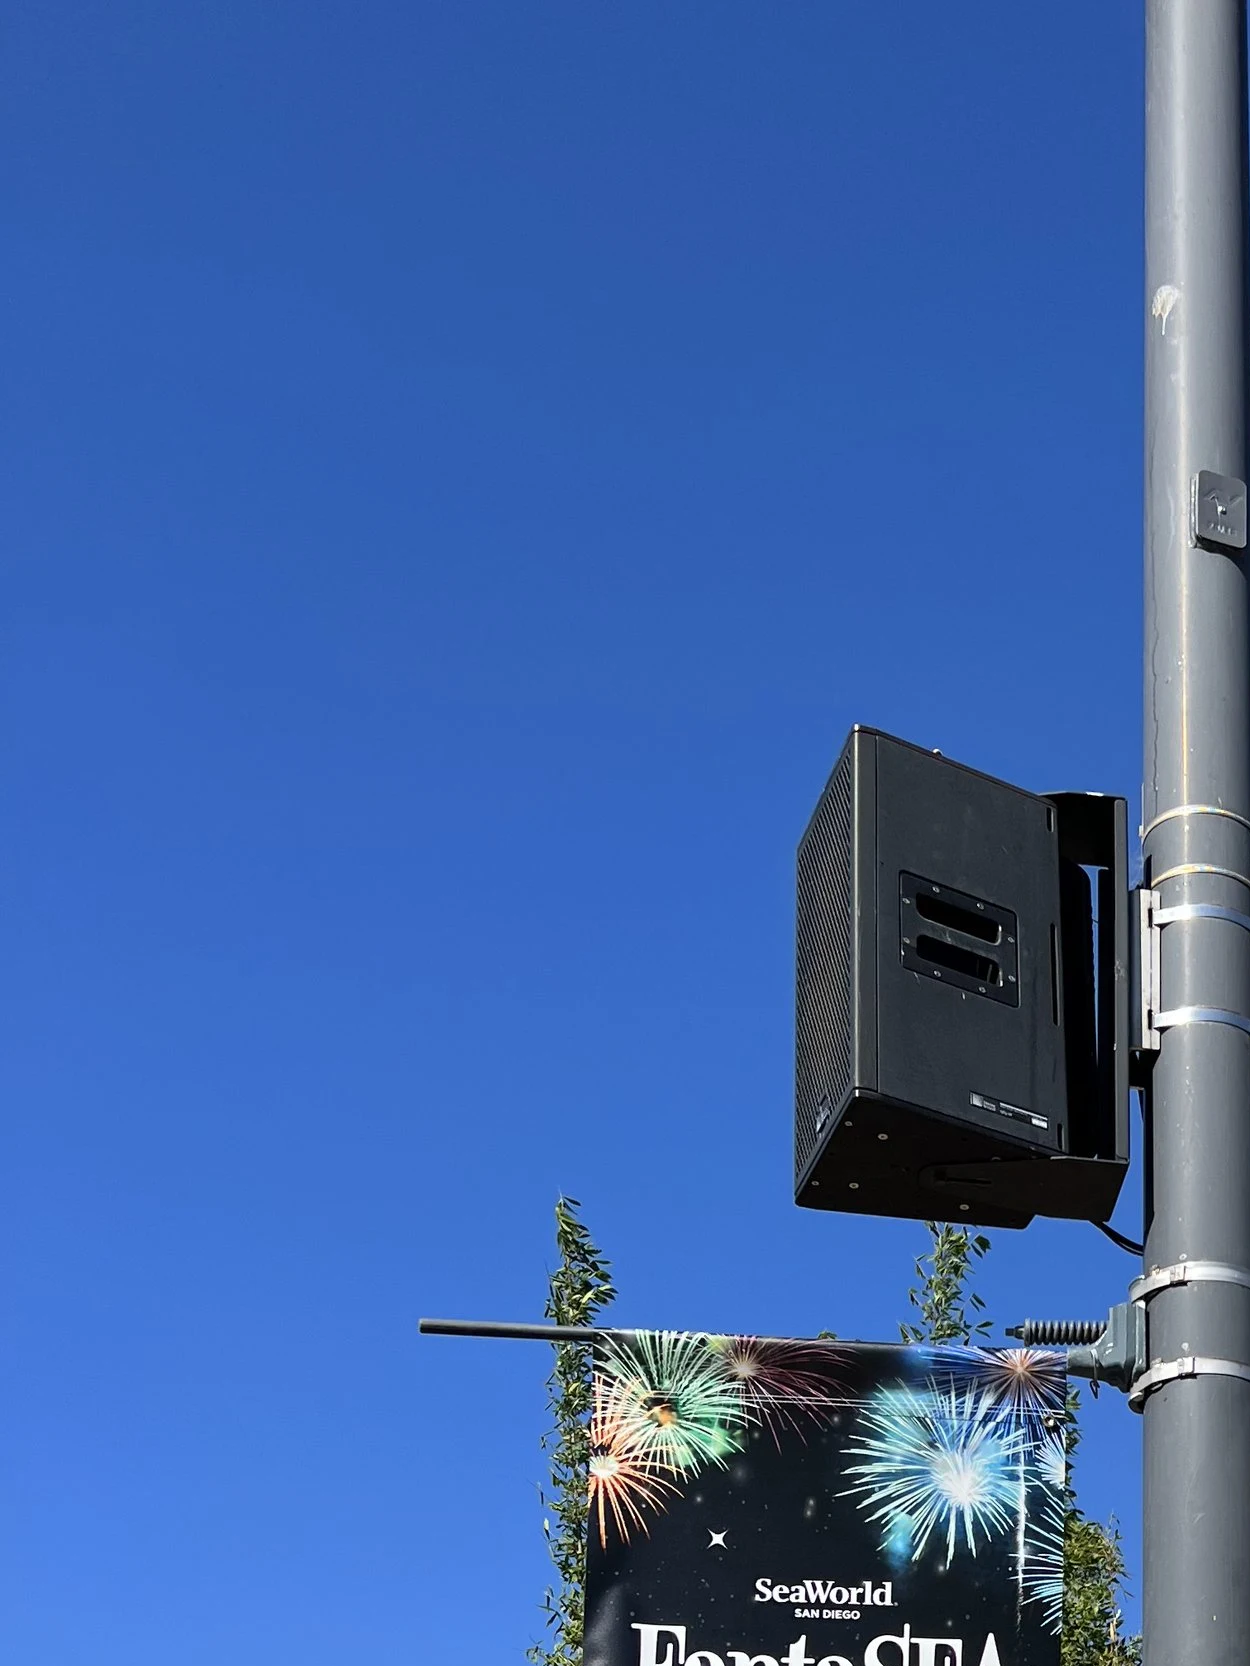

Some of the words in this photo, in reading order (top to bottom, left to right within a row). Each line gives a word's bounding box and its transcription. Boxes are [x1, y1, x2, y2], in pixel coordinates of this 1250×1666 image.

[754, 1577, 893, 1605] SeaWorld
[794, 1608, 820, 1618] SAN
[822, 1609, 861, 1620] DIEGO
